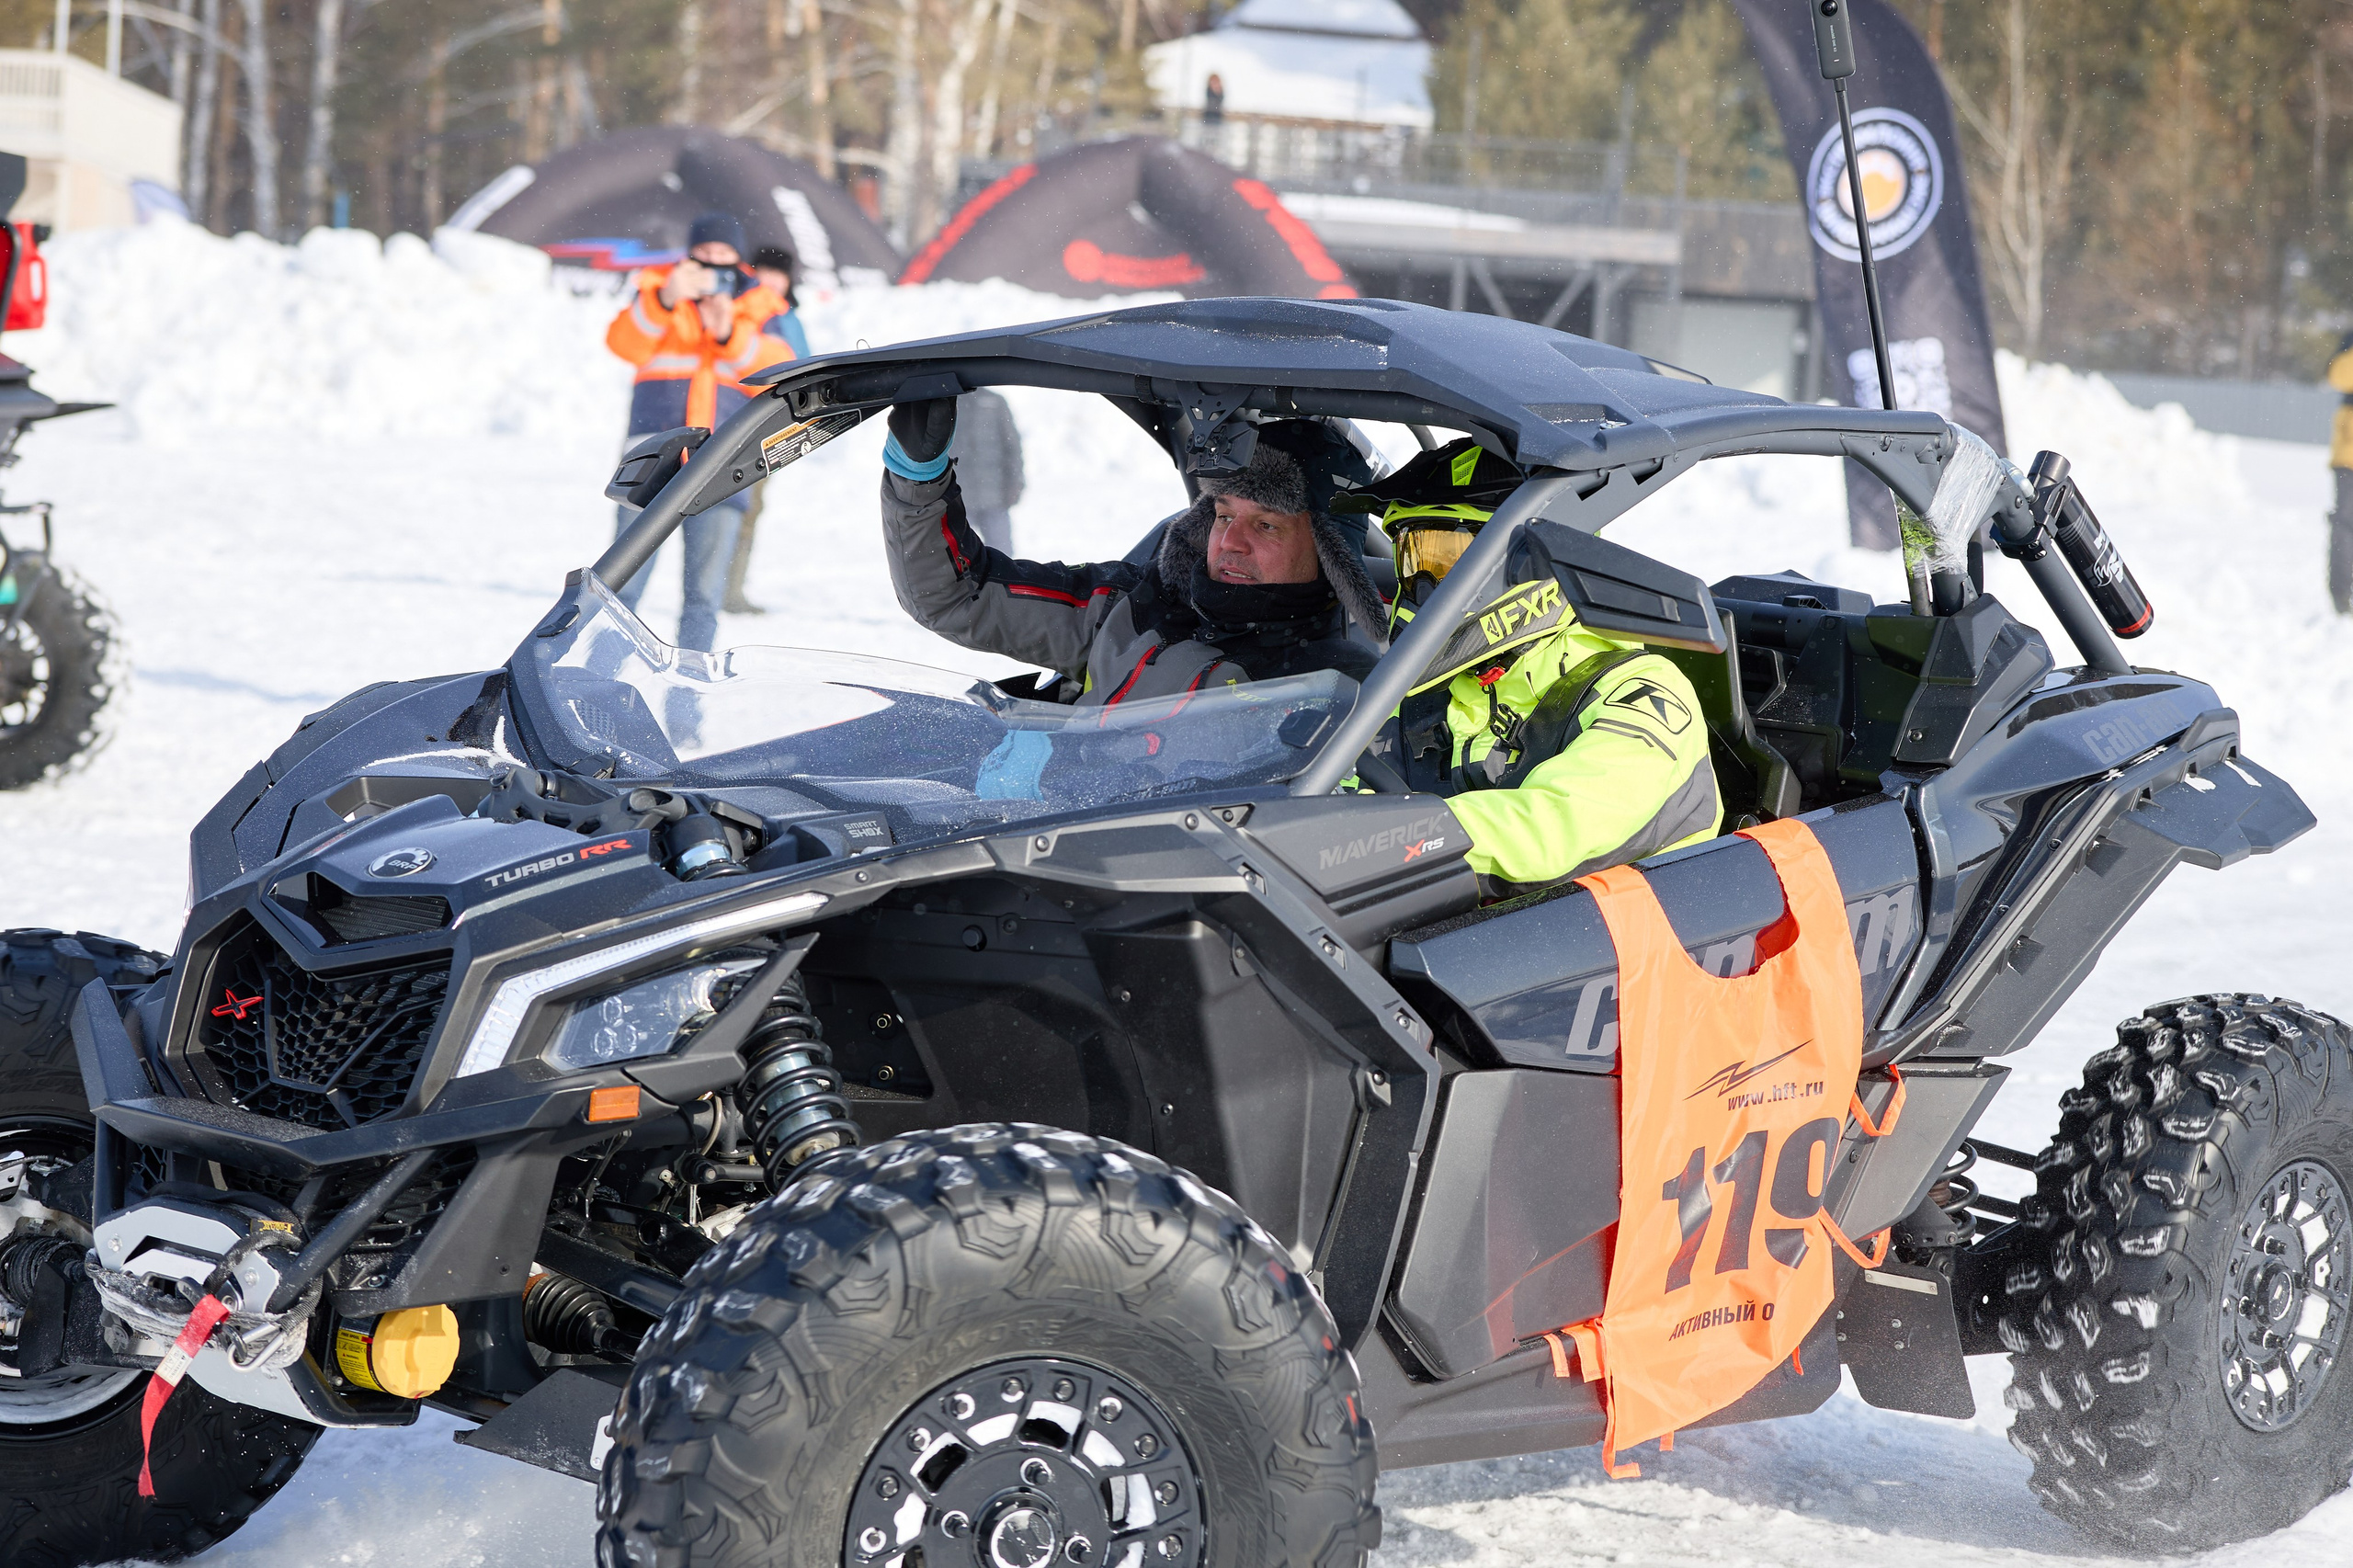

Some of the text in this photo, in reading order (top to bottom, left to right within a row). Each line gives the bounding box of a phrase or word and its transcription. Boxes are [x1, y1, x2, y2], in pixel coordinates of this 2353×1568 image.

[1497, 581, 1563, 636] FXR
[844, 820, 878, 831] SMART
[847, 826, 885, 838] SHOX
[1318, 813, 1445, 870] MAVERICK
[387, 858, 418, 871] BRP
[484, 839, 633, 888] TURBO RR
[1728, 1081, 1824, 1111] www.hft.ru
[1662, 1117, 1841, 1295] 119
[1668, 1300, 1755, 1342] АКТИВНЫЙ
